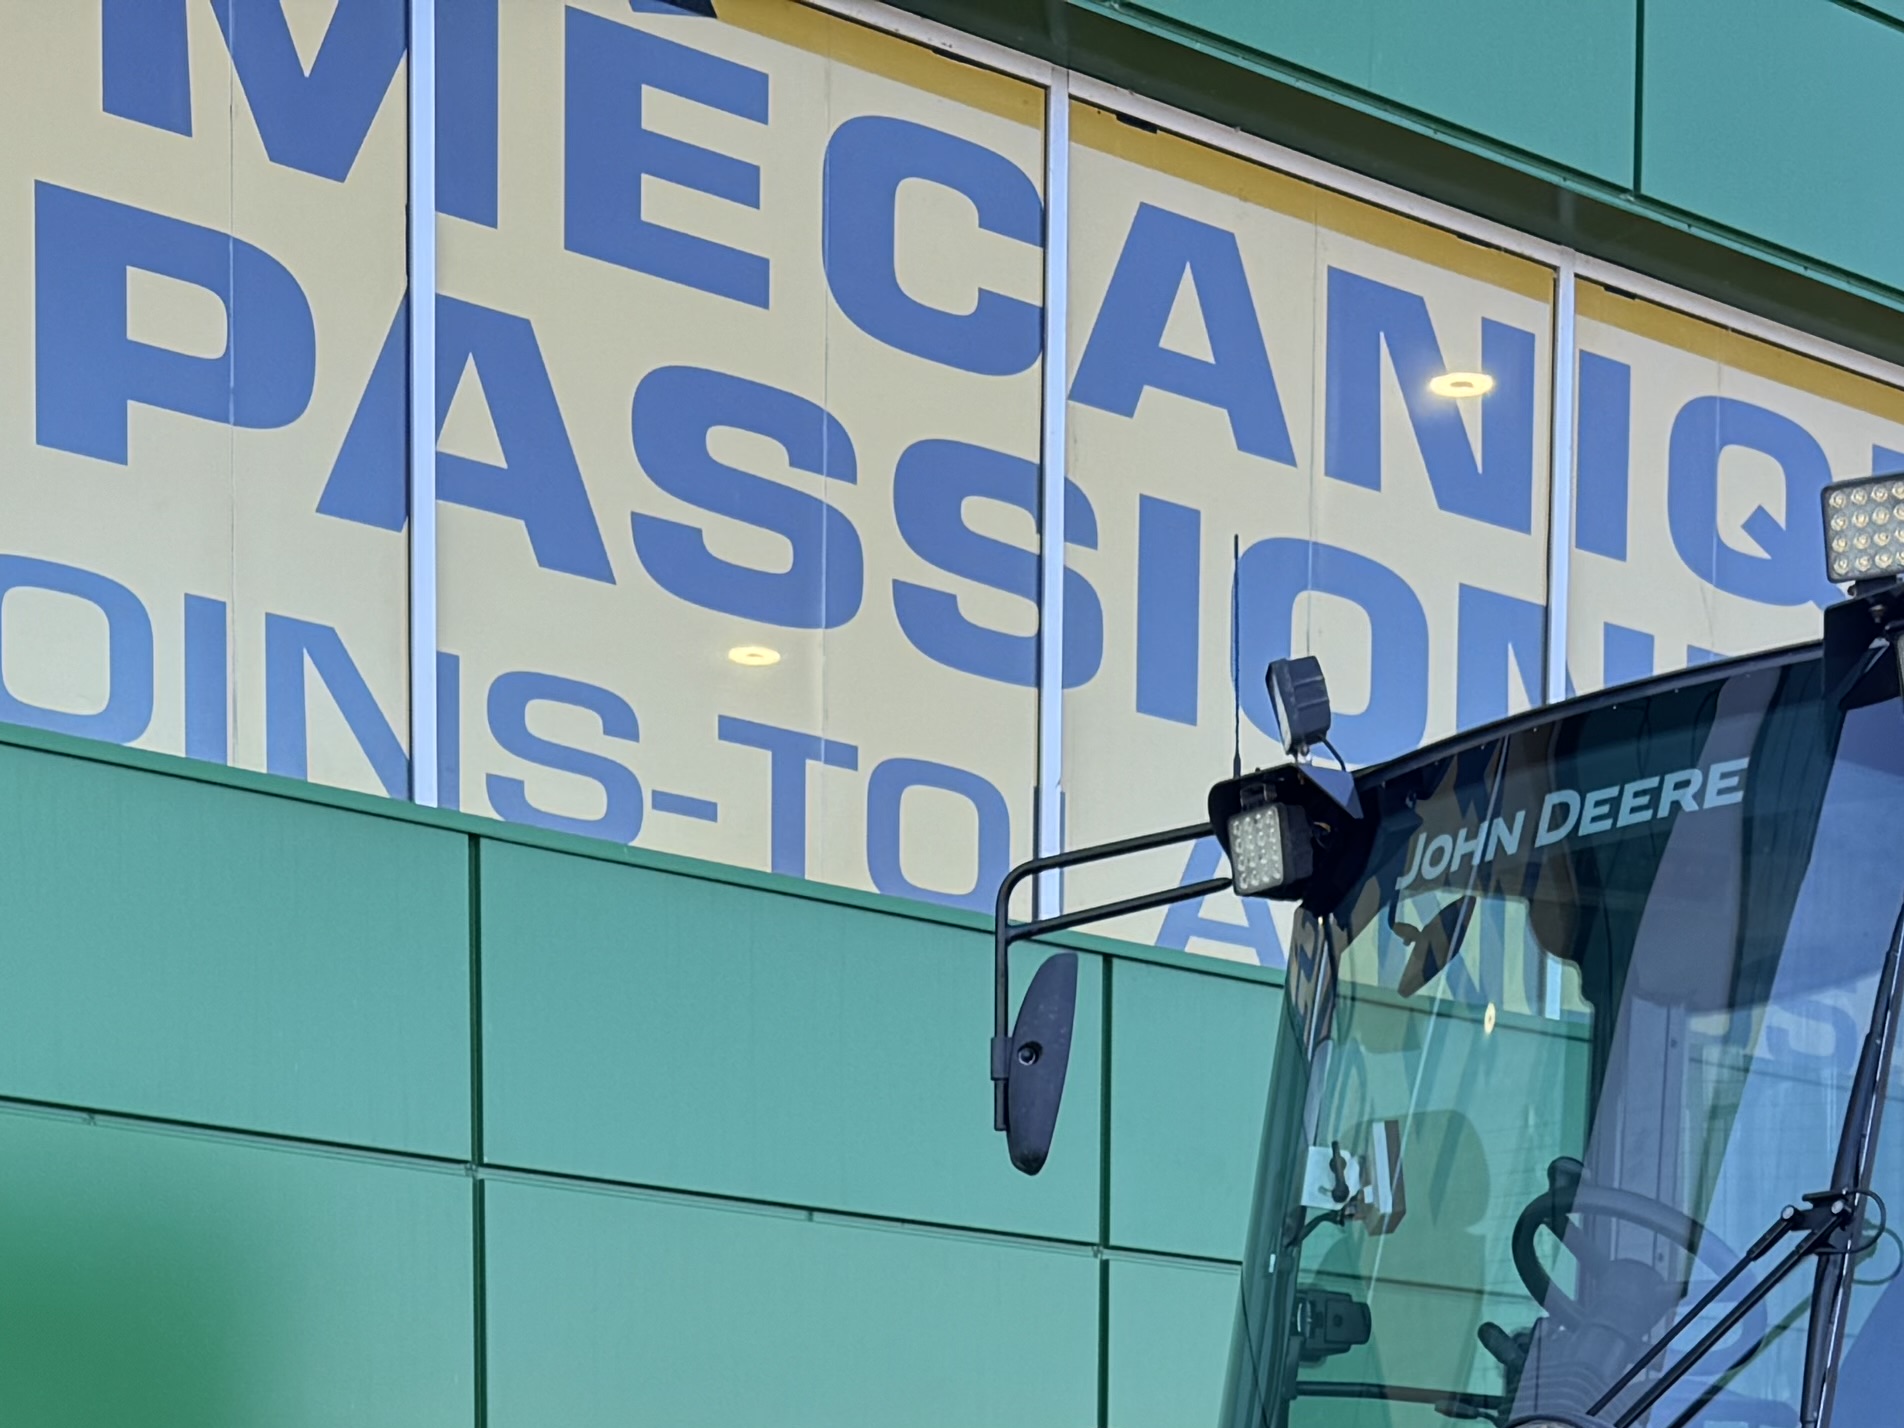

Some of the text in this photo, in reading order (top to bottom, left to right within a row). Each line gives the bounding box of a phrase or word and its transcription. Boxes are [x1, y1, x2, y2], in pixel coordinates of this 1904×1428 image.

[34, 179, 1728, 770] PASSION
[1396, 757, 1750, 890] JOHN DEERE
